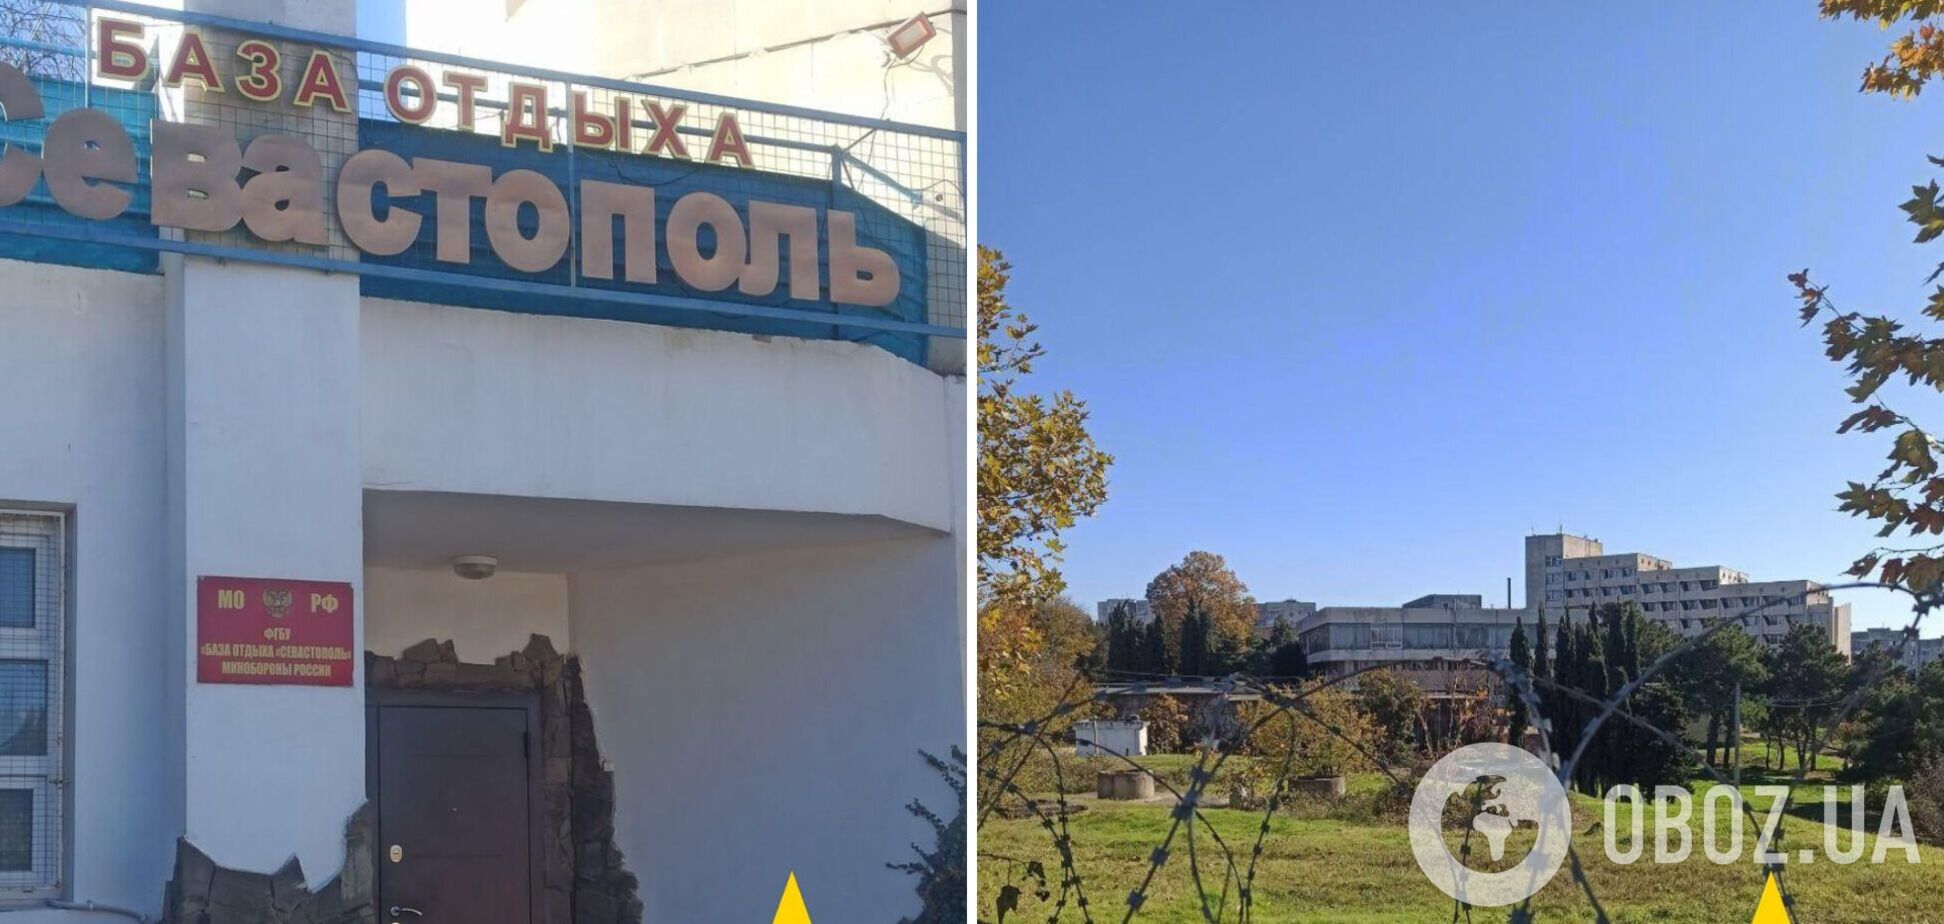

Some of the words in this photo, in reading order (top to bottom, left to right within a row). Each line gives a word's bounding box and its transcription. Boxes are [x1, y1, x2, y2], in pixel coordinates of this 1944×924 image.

[97, 16, 351, 113] БАЗА
[384, 64, 755, 169] ОТДЫХА
[218, 589, 245, 610] МО
[311, 593, 338, 613] РФ
[264, 627, 291, 641] ФГБУ
[232, 645, 274, 659] ОТДЫХА
[222, 661, 293, 676] МИНОБОРОНЫ
[294, 663, 331, 677] РОССИИ
